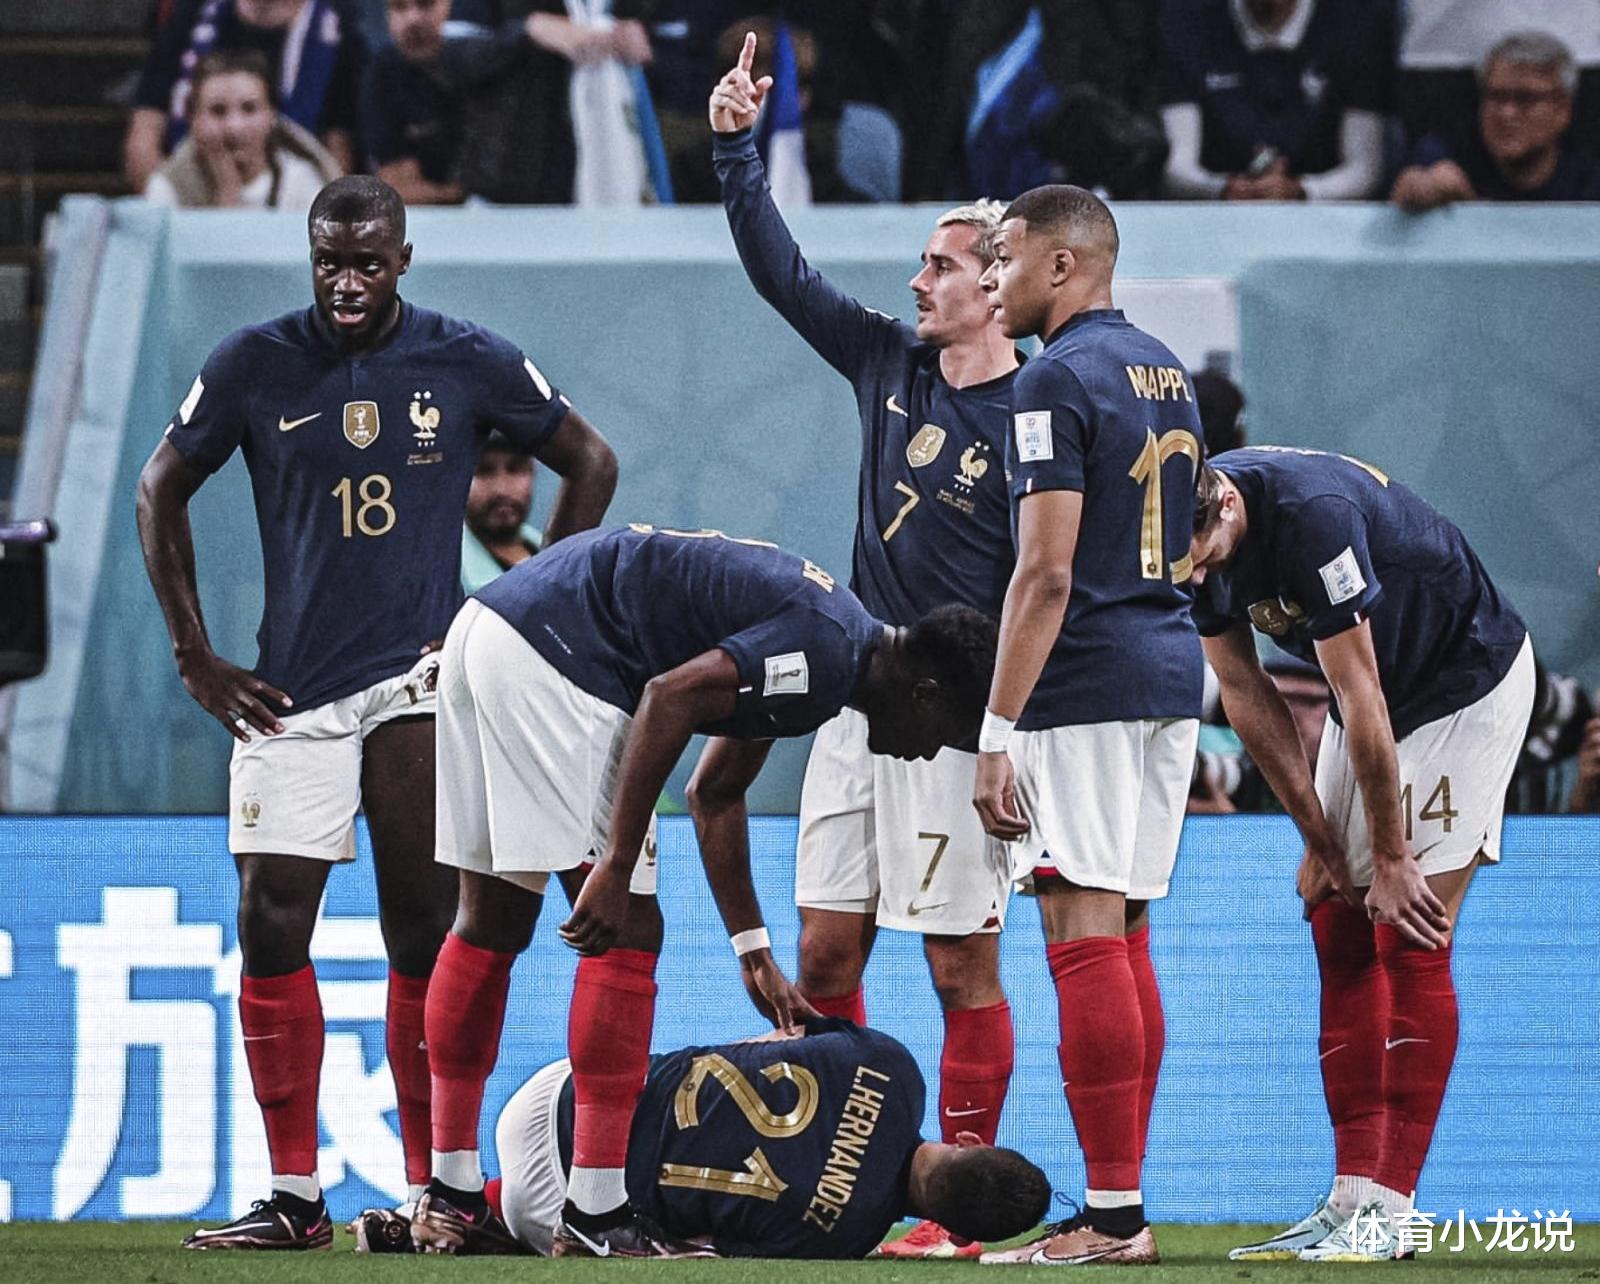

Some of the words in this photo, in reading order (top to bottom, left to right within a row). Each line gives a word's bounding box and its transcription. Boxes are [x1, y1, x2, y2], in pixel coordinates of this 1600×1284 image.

[331, 474, 396, 538] 18
[882, 479, 920, 542] 7
[1399, 774, 1459, 841] 14
[917, 831, 950, 892] 7
[658, 1052, 820, 1202] 21
[803, 1064, 891, 1234] L.HERNANDEZ
